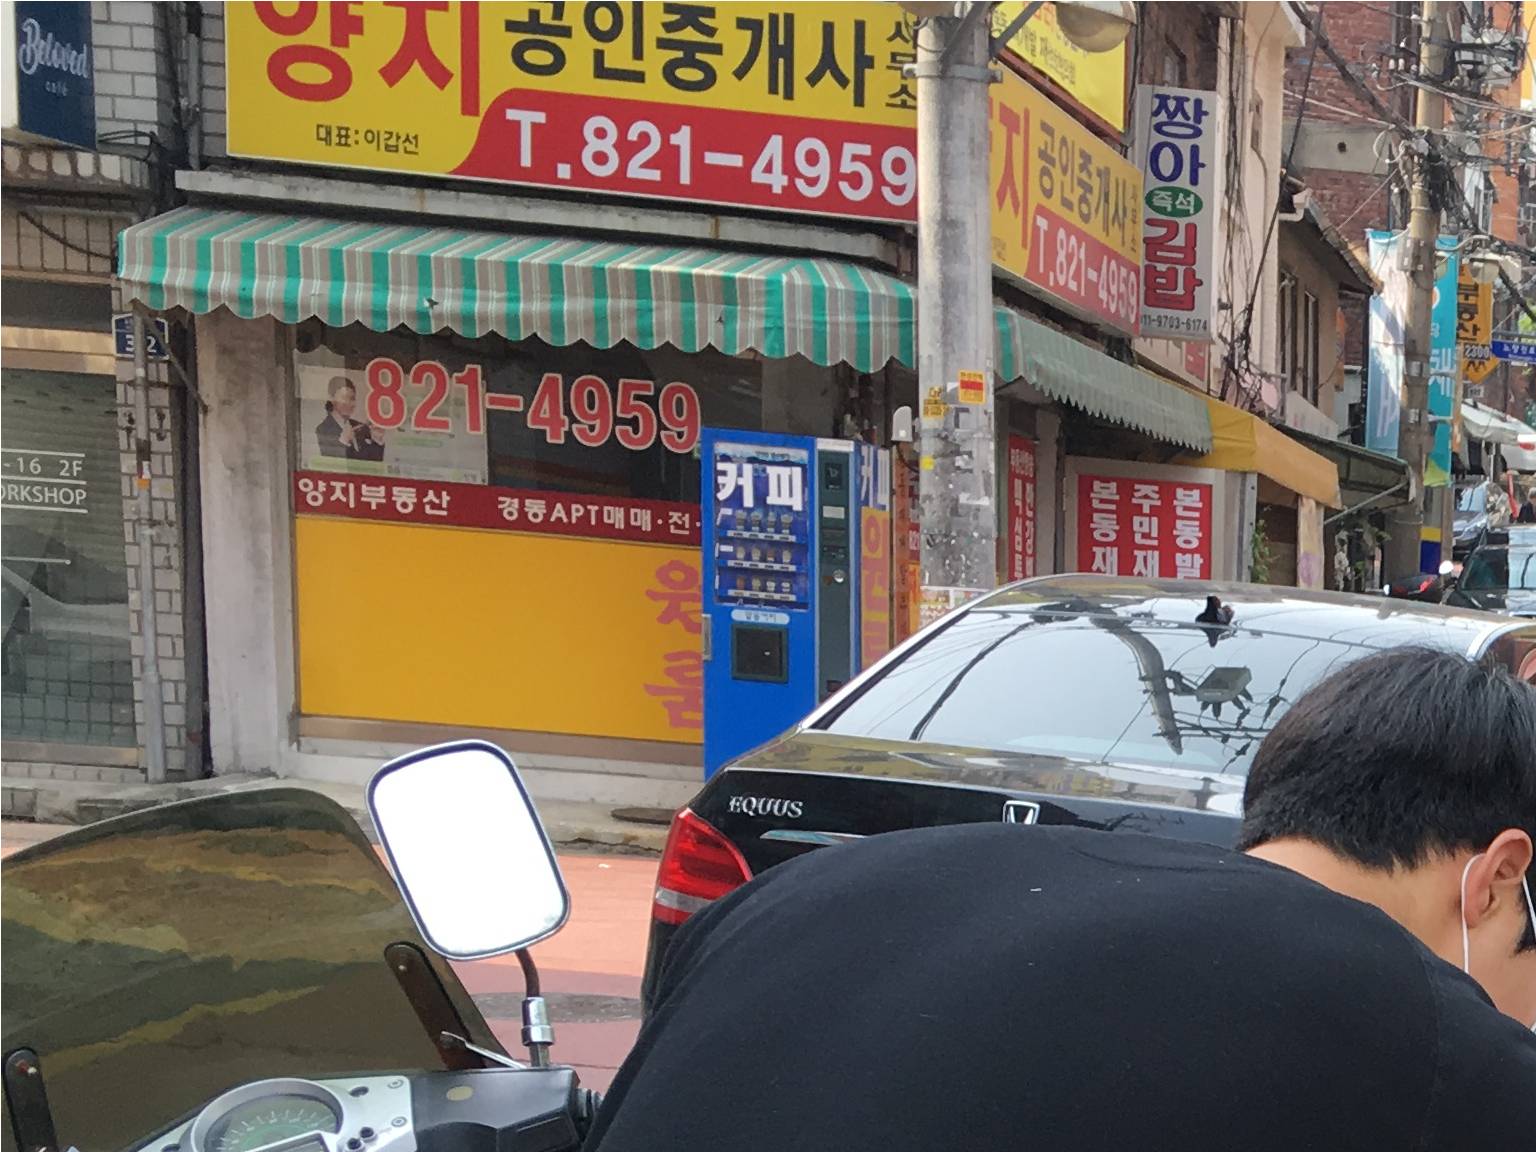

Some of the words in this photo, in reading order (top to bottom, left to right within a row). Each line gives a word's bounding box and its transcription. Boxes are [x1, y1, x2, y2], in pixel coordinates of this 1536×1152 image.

[18, 17, 89, 79] Beloved
[255, 0, 480, 117] 양지
[504, 0, 874, 108] 공인중개사
[505, 108, 917, 206] T.821-4959
[989, 95, 1030, 250] 지
[1037, 119, 1128, 247] 공인중개사
[1150, 93, 1209, 186] 짱아
[1152, 190, 1196, 215] 즉석
[1036, 215, 1138, 325] T.821-4959
[1143, 218, 1204, 311] 김밥
[365, 357, 701, 453] 821-4959
[59, 460, 83, 477] 2F
[298, 477, 451, 517] 양지부동산
[715, 461, 803, 512] 커피
[728, 796, 803, 818] EQUUS
